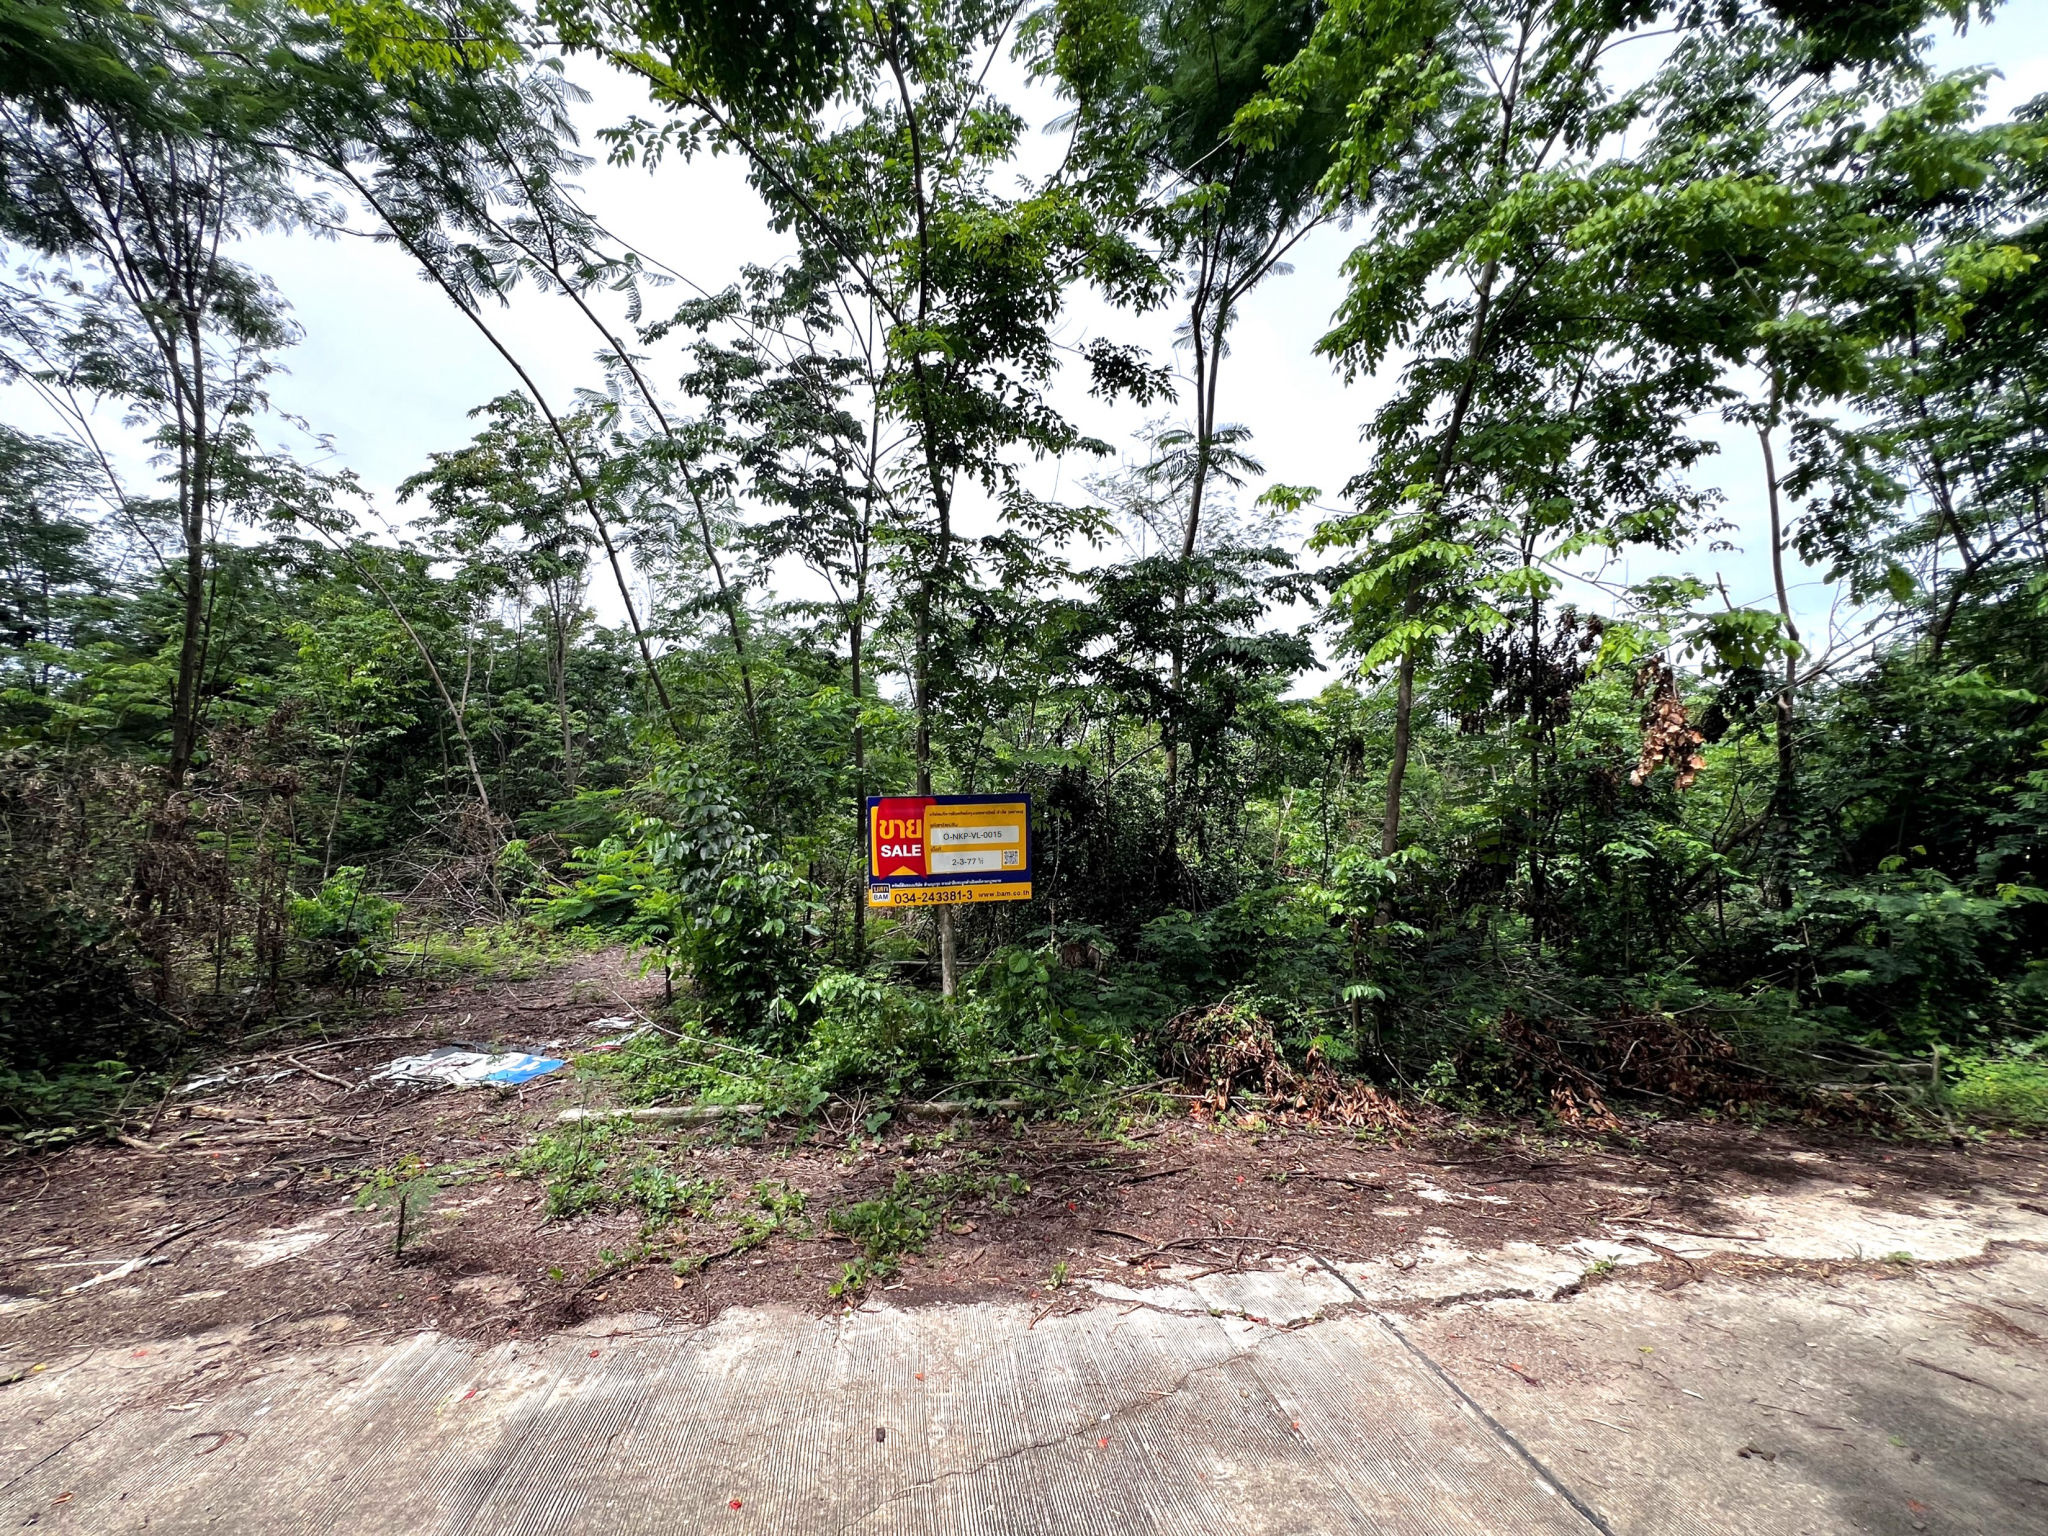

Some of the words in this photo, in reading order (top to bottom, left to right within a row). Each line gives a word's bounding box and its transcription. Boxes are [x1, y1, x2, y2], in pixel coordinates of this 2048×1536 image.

[879, 819, 922, 839] ขาย
[943, 831, 1002, 841] O-NKP-VL-0015
[881, 844, 922, 858] SALE
[894, 890, 973, 904] 034-243381-3
